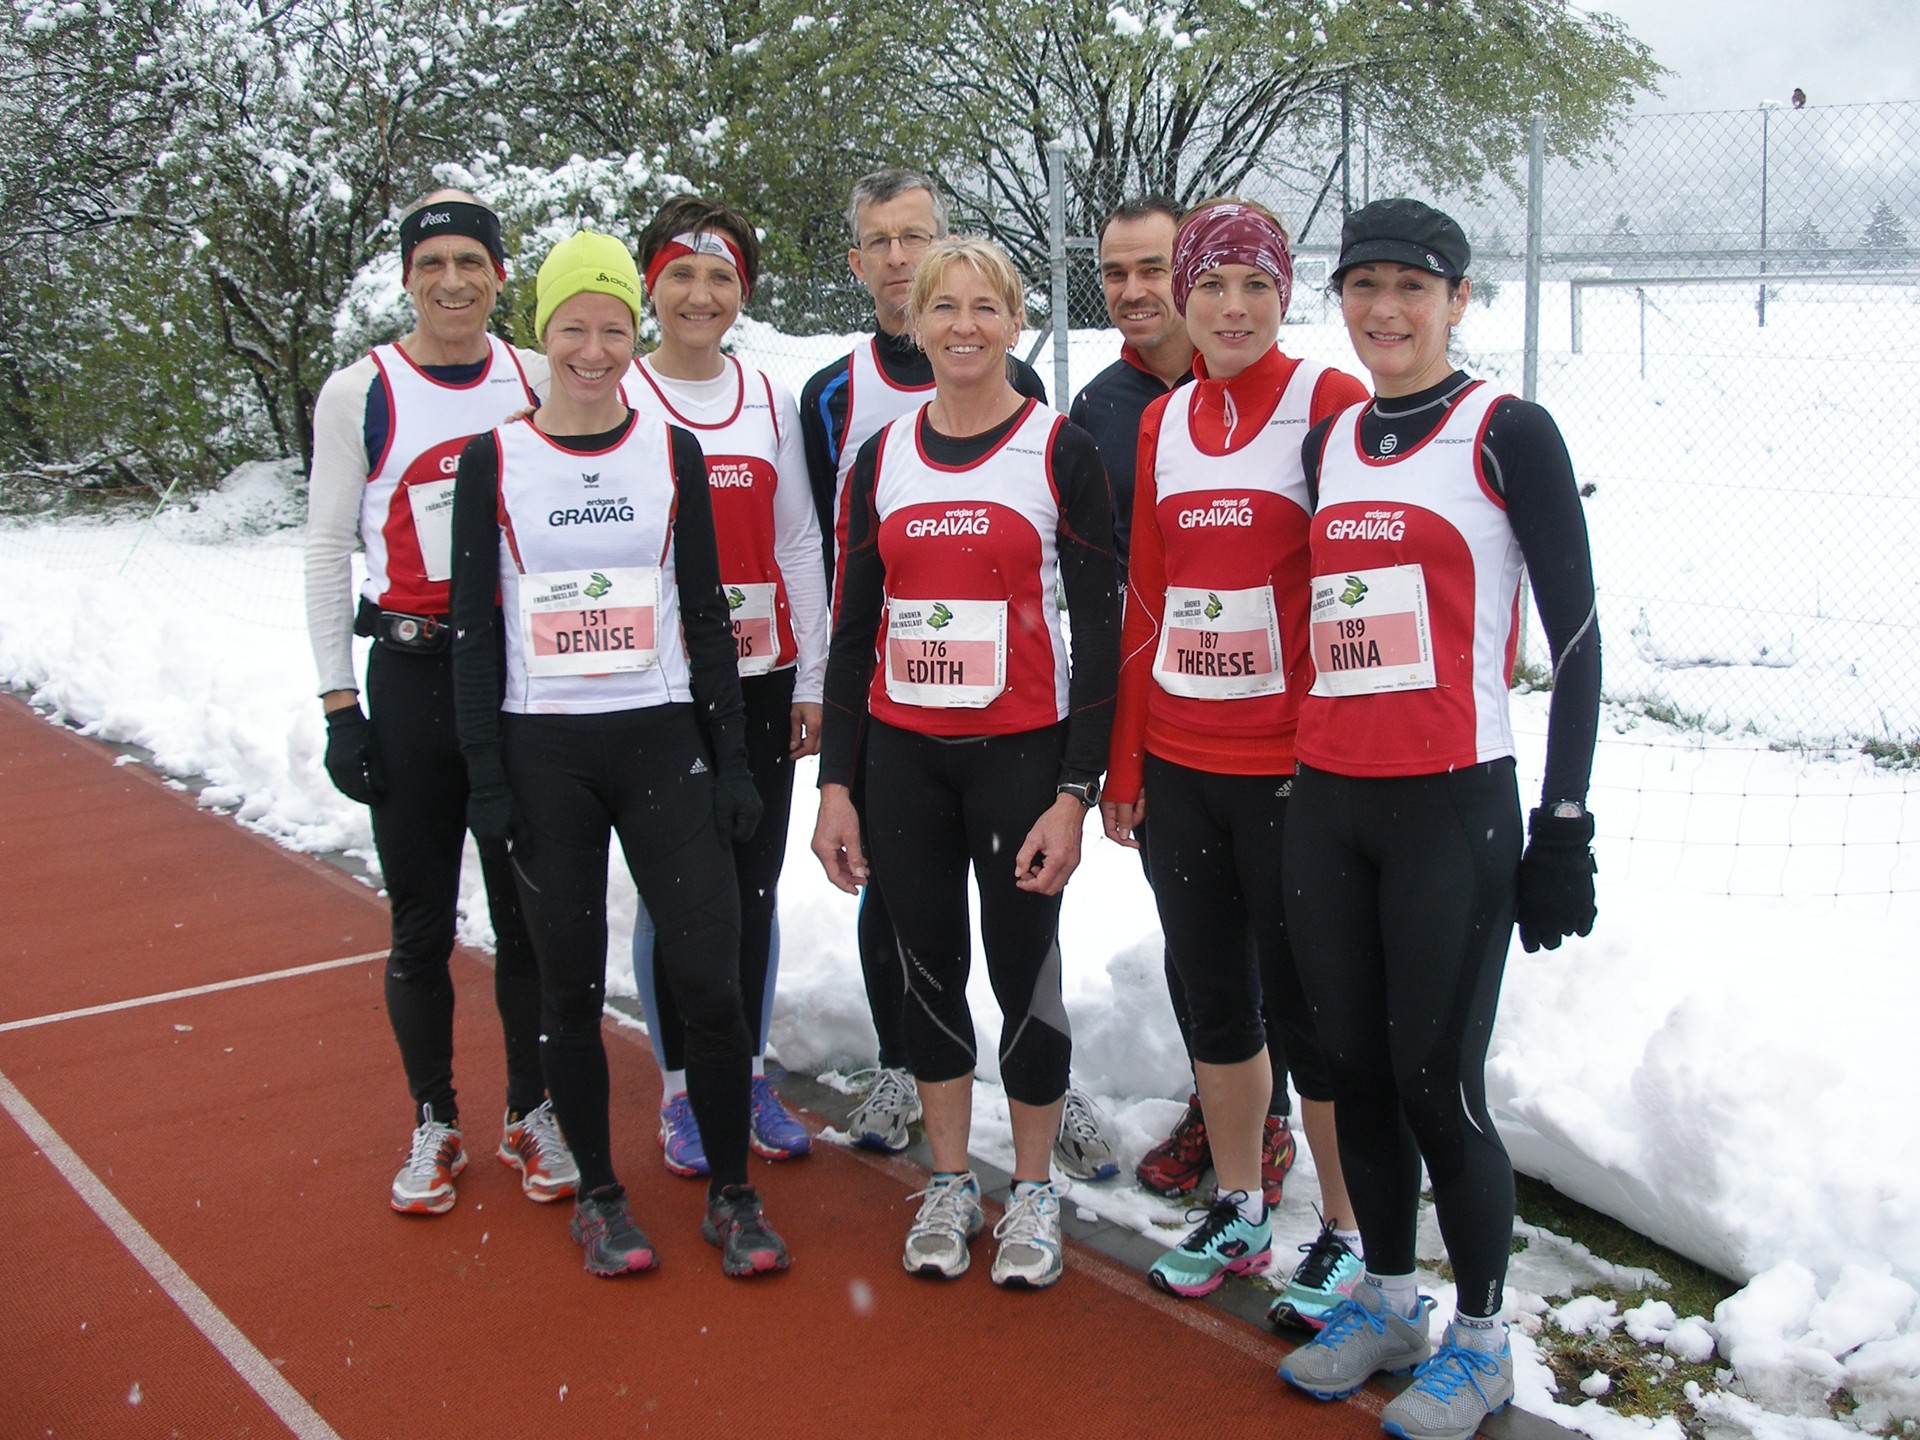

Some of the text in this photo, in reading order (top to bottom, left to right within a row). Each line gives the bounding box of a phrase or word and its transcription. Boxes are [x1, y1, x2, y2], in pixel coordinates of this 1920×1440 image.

[711, 463, 738, 473] erdgas
[586, 498, 616, 507] erdgas
[1211, 498, 1238, 508] erdgas
[548, 505, 635, 527] GRAVAG
[945, 508, 974, 519] erdgas
[1178, 507, 1254, 529] GRAVAG
[1364, 510, 1392, 520] erdgas
[905, 517, 991, 538] GRAVAG
[1325, 519, 1406, 542] GRAVAG
[579, 609, 608, 627] 151
[1336, 618, 1366, 640] 189
[555, 626, 635, 654] DENISE
[921, 641, 947, 657] 176
[1199, 631, 1219, 649] 187
[1177, 648, 1256, 677] THERESE
[1330, 639, 1382, 671] RINA
[907, 659, 963, 685] EDITH
